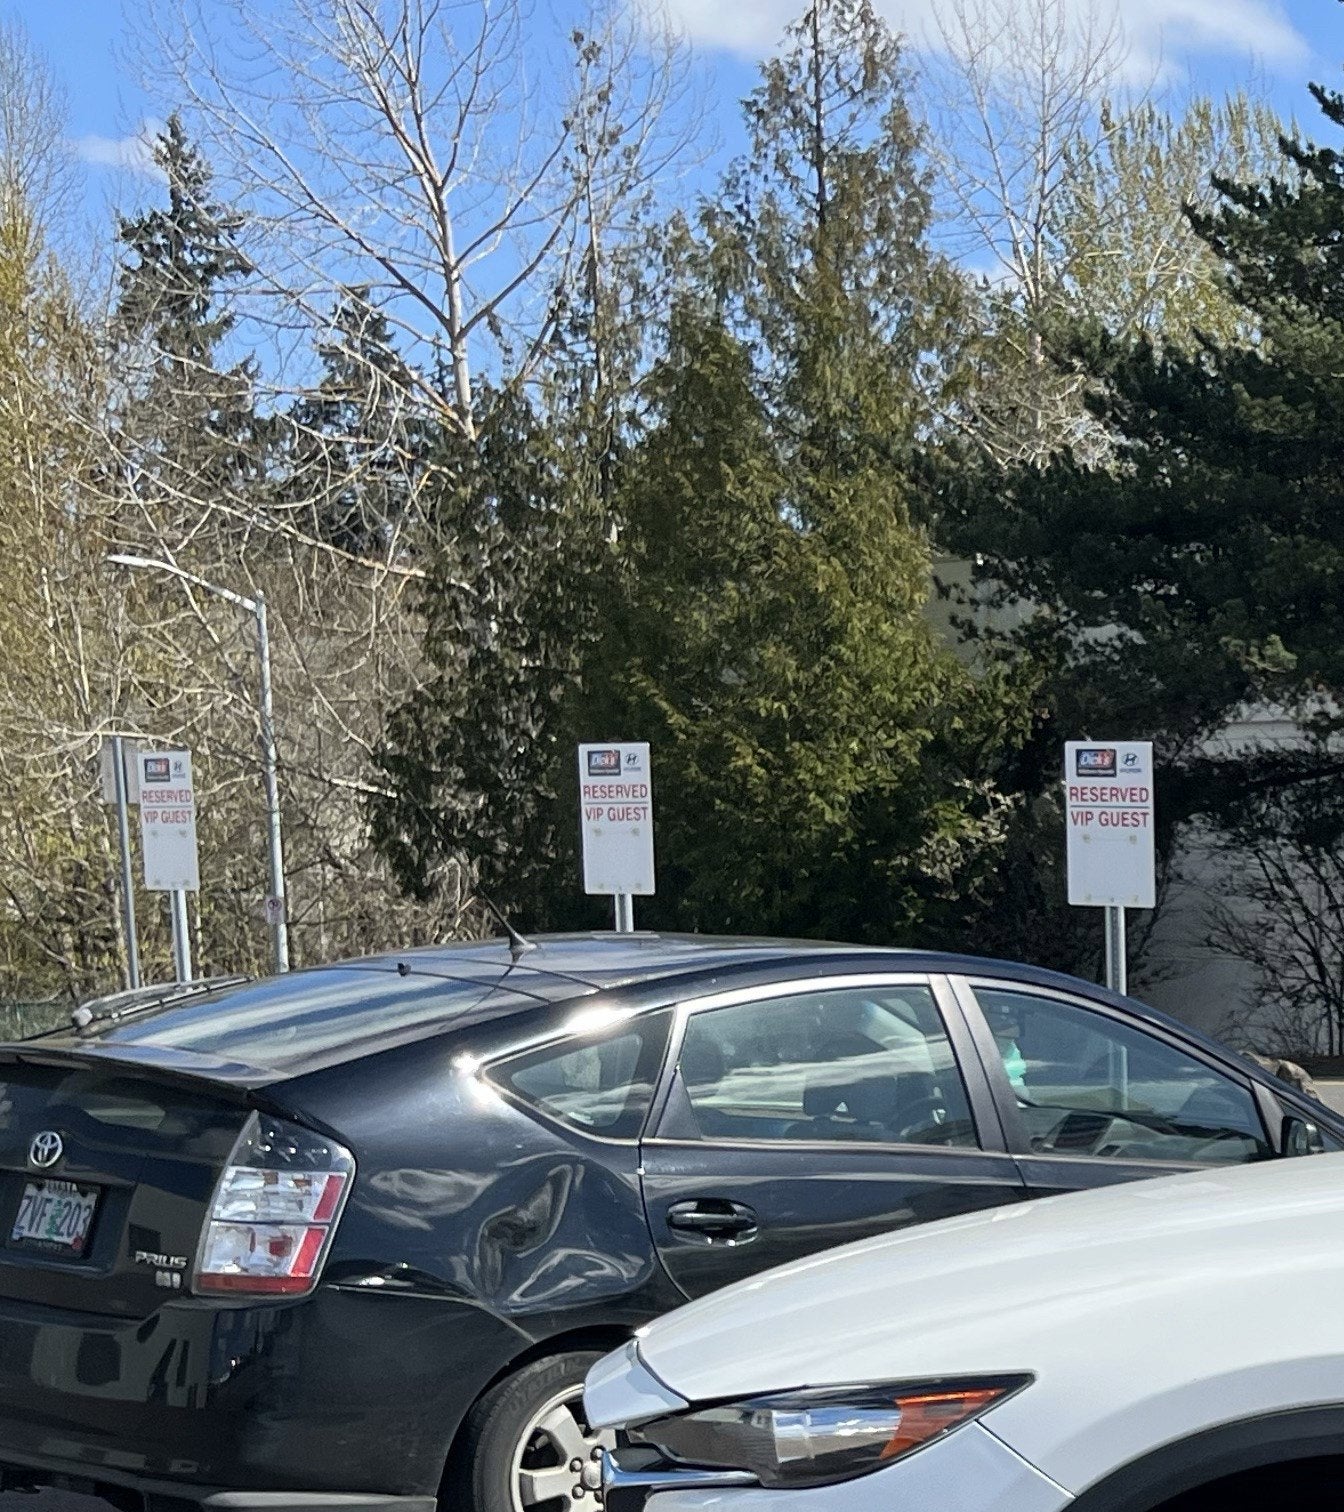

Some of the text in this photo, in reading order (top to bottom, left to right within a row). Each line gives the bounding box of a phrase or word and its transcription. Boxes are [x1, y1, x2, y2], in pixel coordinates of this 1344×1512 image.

[142, 790, 192, 803] RESERVED
[583, 784, 648, 799] RESERVED
[1069, 787, 1149, 803] RESERVED
[144, 810, 192, 824] VIP GUEST
[585, 807, 648, 821] VIP GUEST
[1071, 812, 1149, 828] VIP GUEST
[135, 1251, 188, 1269] PRIUS
